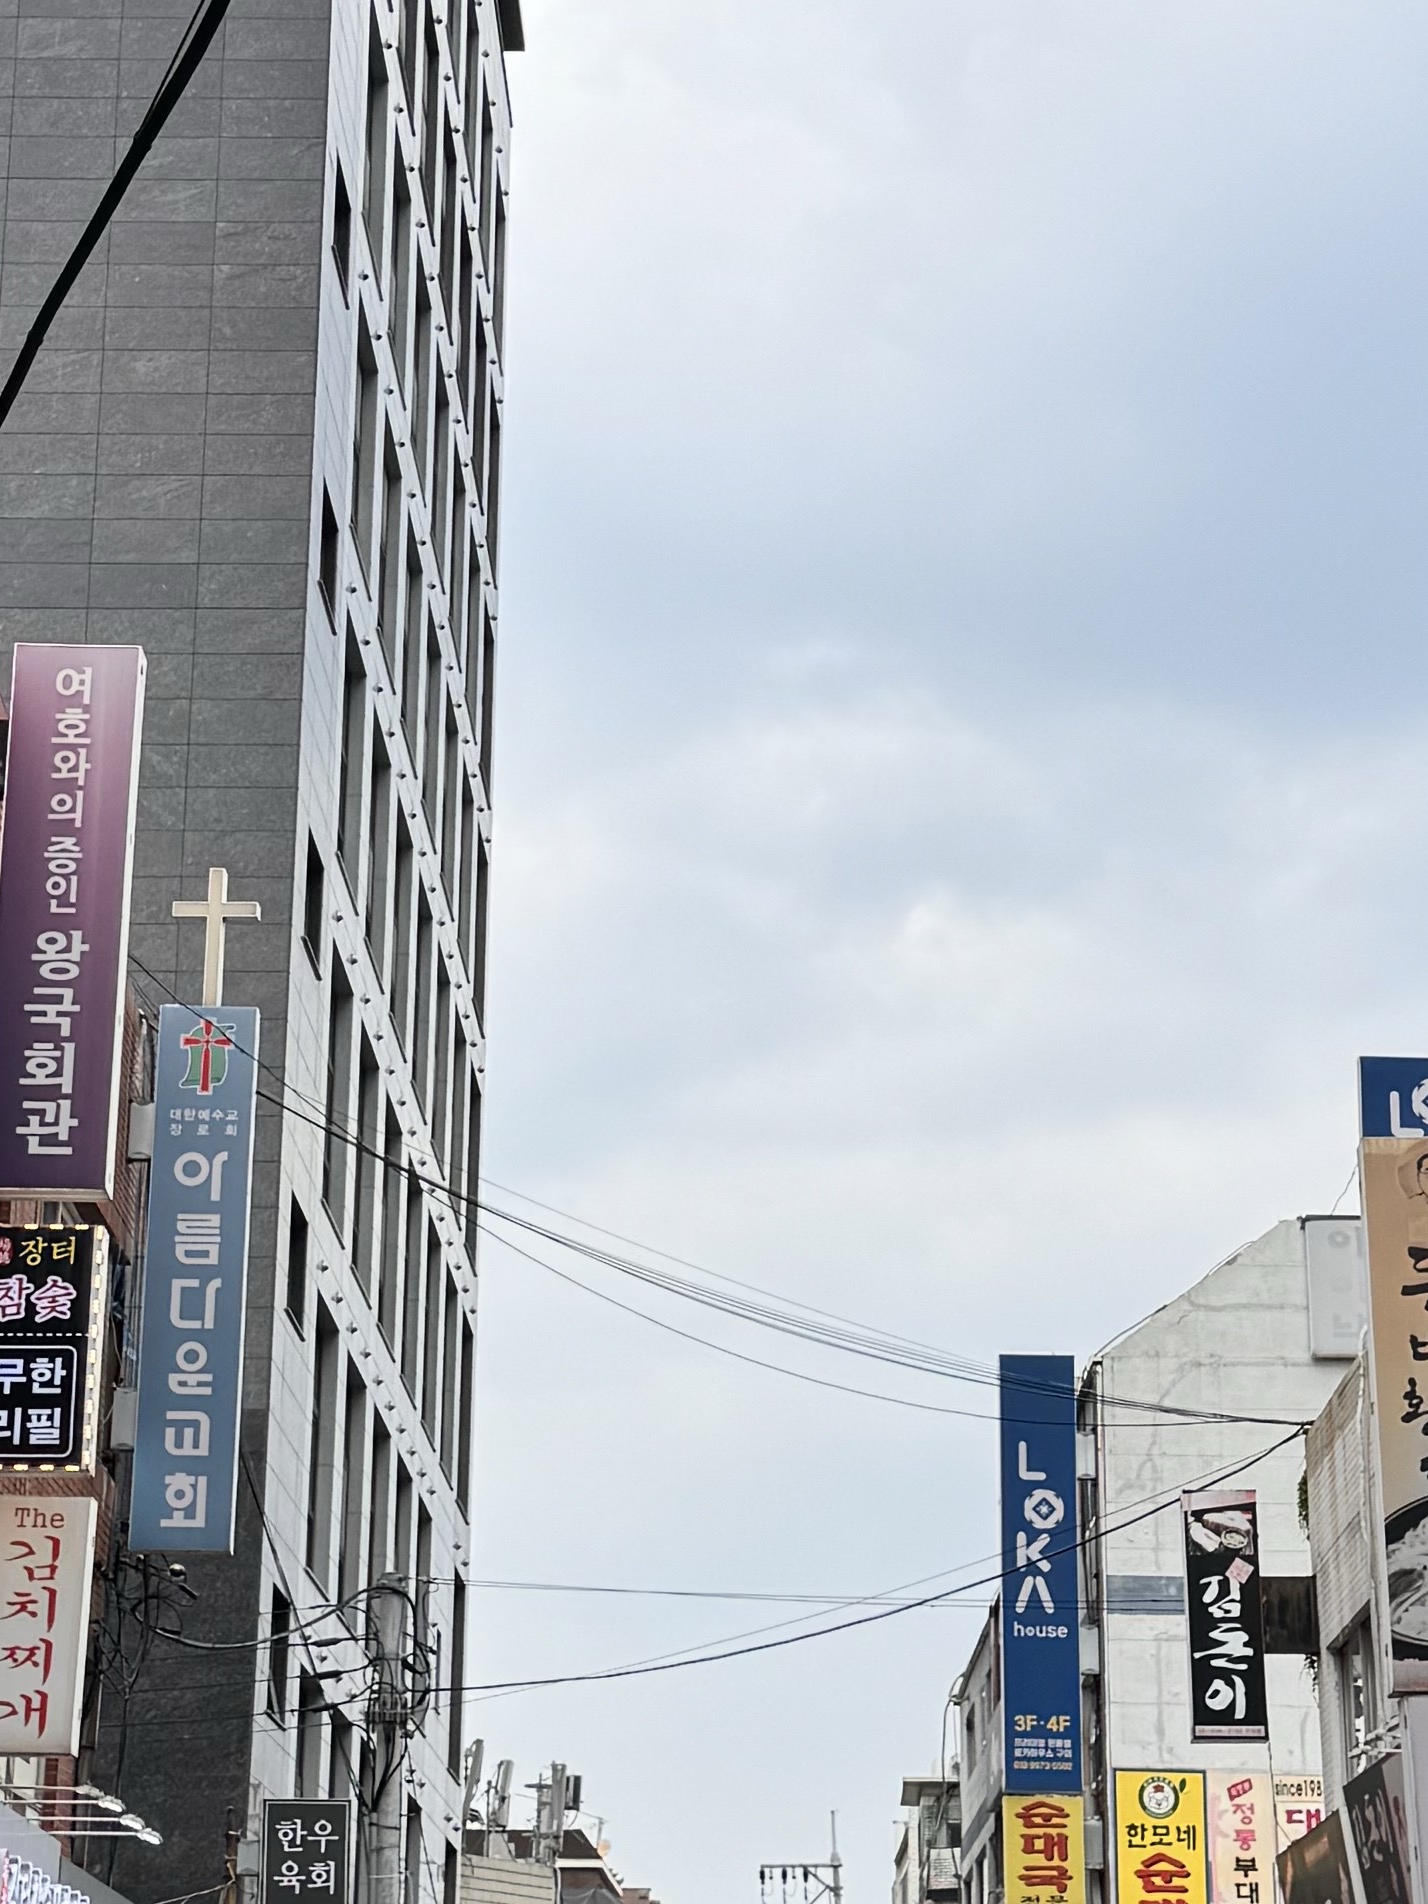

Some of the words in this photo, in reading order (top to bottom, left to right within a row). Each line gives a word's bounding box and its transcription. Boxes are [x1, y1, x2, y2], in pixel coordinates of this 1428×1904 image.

[47, 664, 92, 829] 여호와의
[44, 835, 84, 916] 증인
[15, 929, 90, 1158] 왕국회관
[168, 1107, 240, 1122] 대한예수교
[18, 1235, 77, 1266] 장터
[158, 1149, 229, 1531] 아름다운교회
[13, 1506, 65, 1530] The
[1013, 1622, 1069, 1640] house
[1194, 1572, 1256, 1722] 김돈이
[274, 1817, 339, 1854] 한우
[1014, 1800, 1074, 1894] 순대국
[1124, 1823, 1198, 1852] 한모네
[1231, 1801, 1259, 1852] 정통
[273, 1858, 335, 1896] 육회
